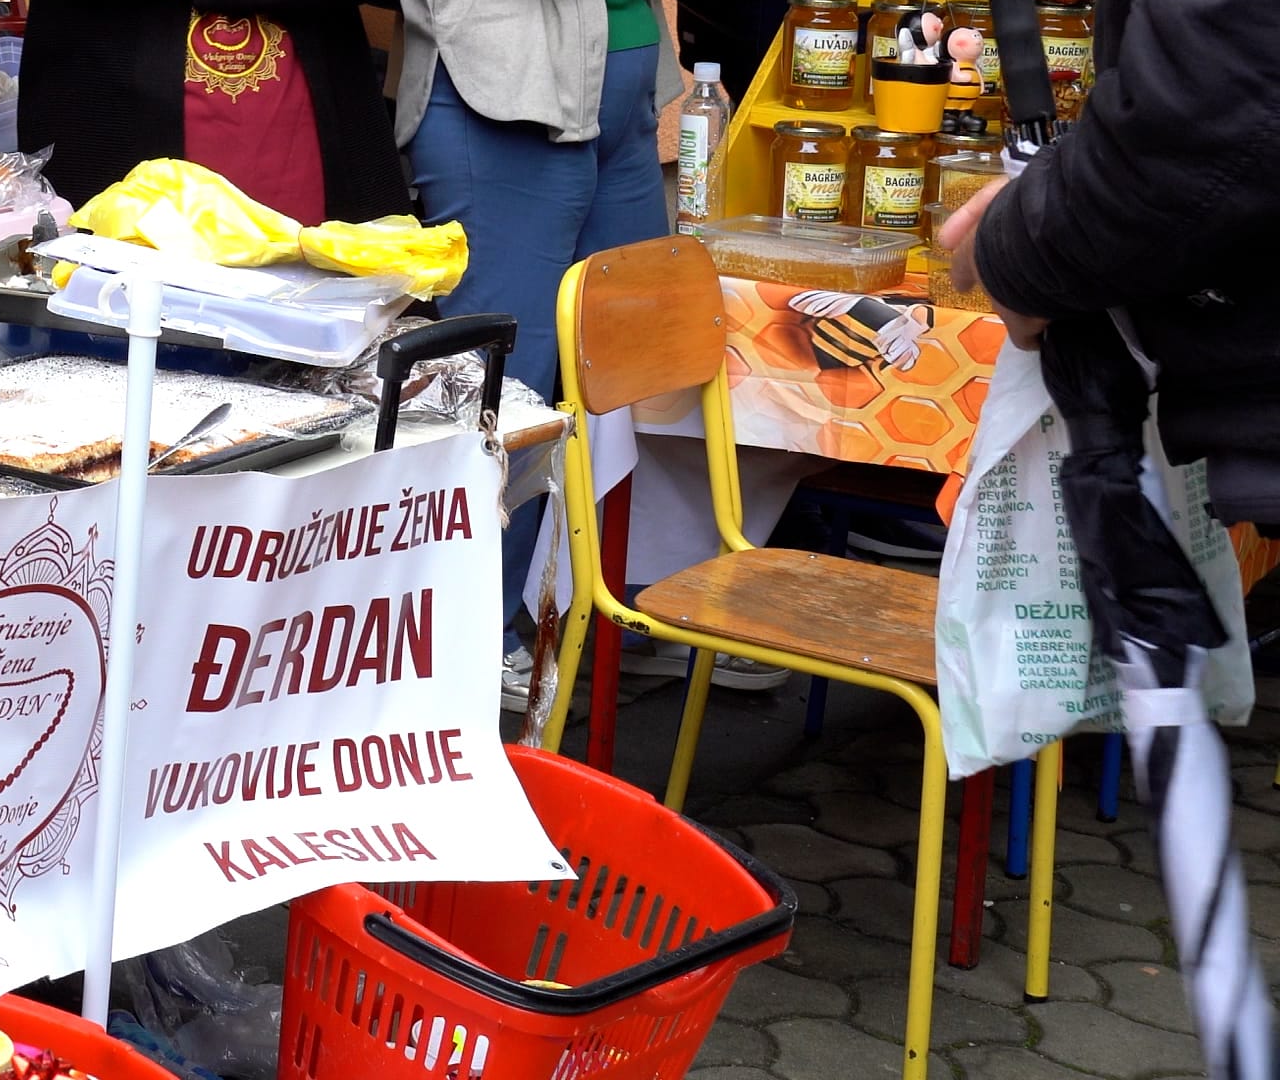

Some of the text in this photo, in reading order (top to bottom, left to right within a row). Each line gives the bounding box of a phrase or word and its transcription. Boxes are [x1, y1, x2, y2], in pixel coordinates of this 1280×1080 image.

[187, 486, 473, 583] UDRUŽENJE ŽENA
[185, 588, 434, 713] ĐERDAN
[1014, 629, 1073, 640] LUKAVAC
[1015, 641, 1089, 652] SREBRENIK
[1016, 653, 1088, 664] GRADAČAC
[1018, 666, 1078, 677] KALESIJA
[144, 728, 474, 819] VUKOVIJE DONJE
[203, 822, 438, 883] KALESIJA
